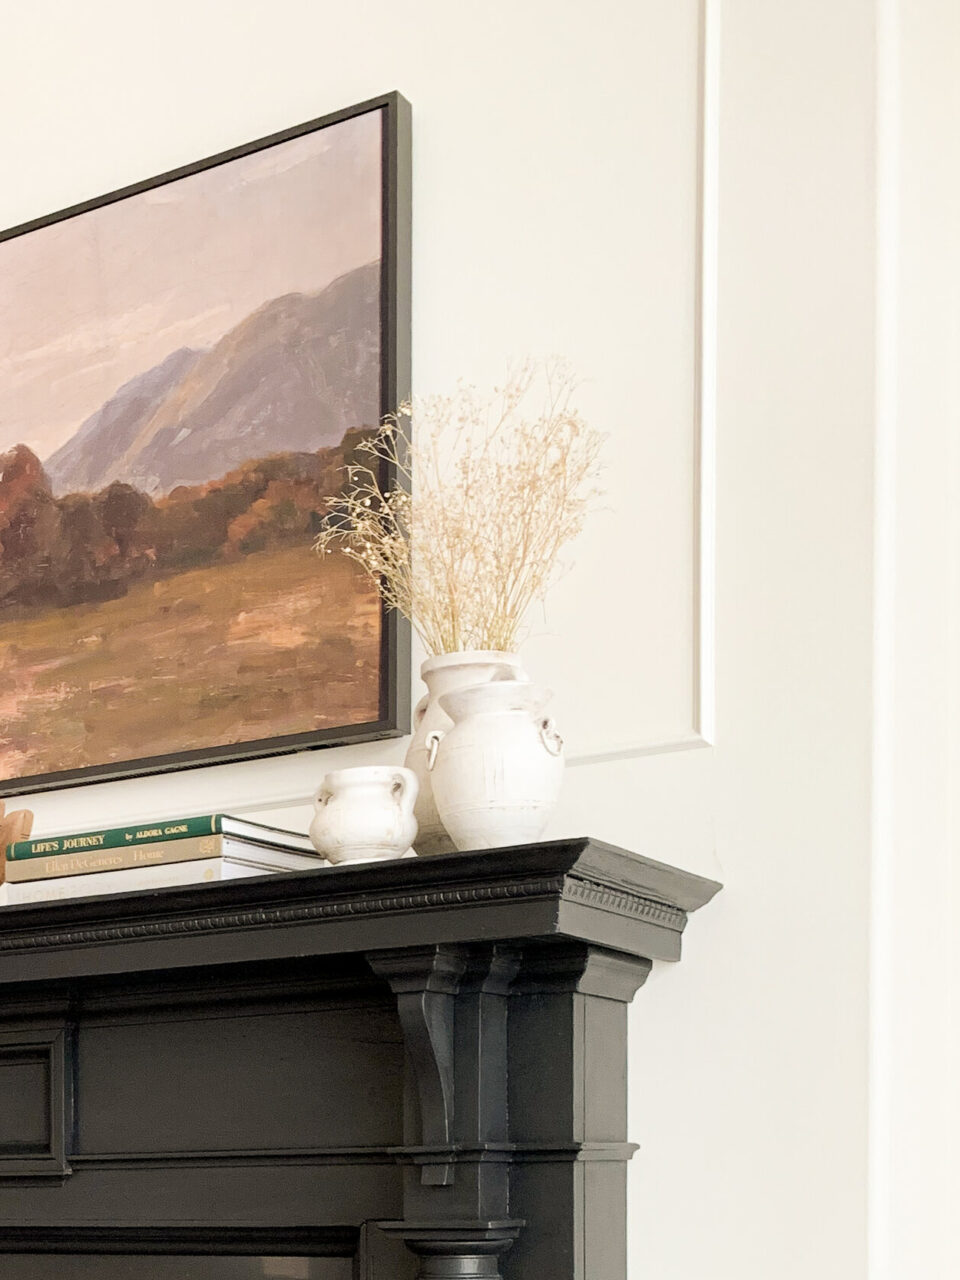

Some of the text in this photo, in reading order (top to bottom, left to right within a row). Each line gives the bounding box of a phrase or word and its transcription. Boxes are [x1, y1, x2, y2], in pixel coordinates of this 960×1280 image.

[31, 841, 59, 854] LIFE'S
[62, 834, 105, 850] JOURNEY
[125, 833, 134, 842] by
[45, 849, 165, 874] Ellen DeGeneres Home
